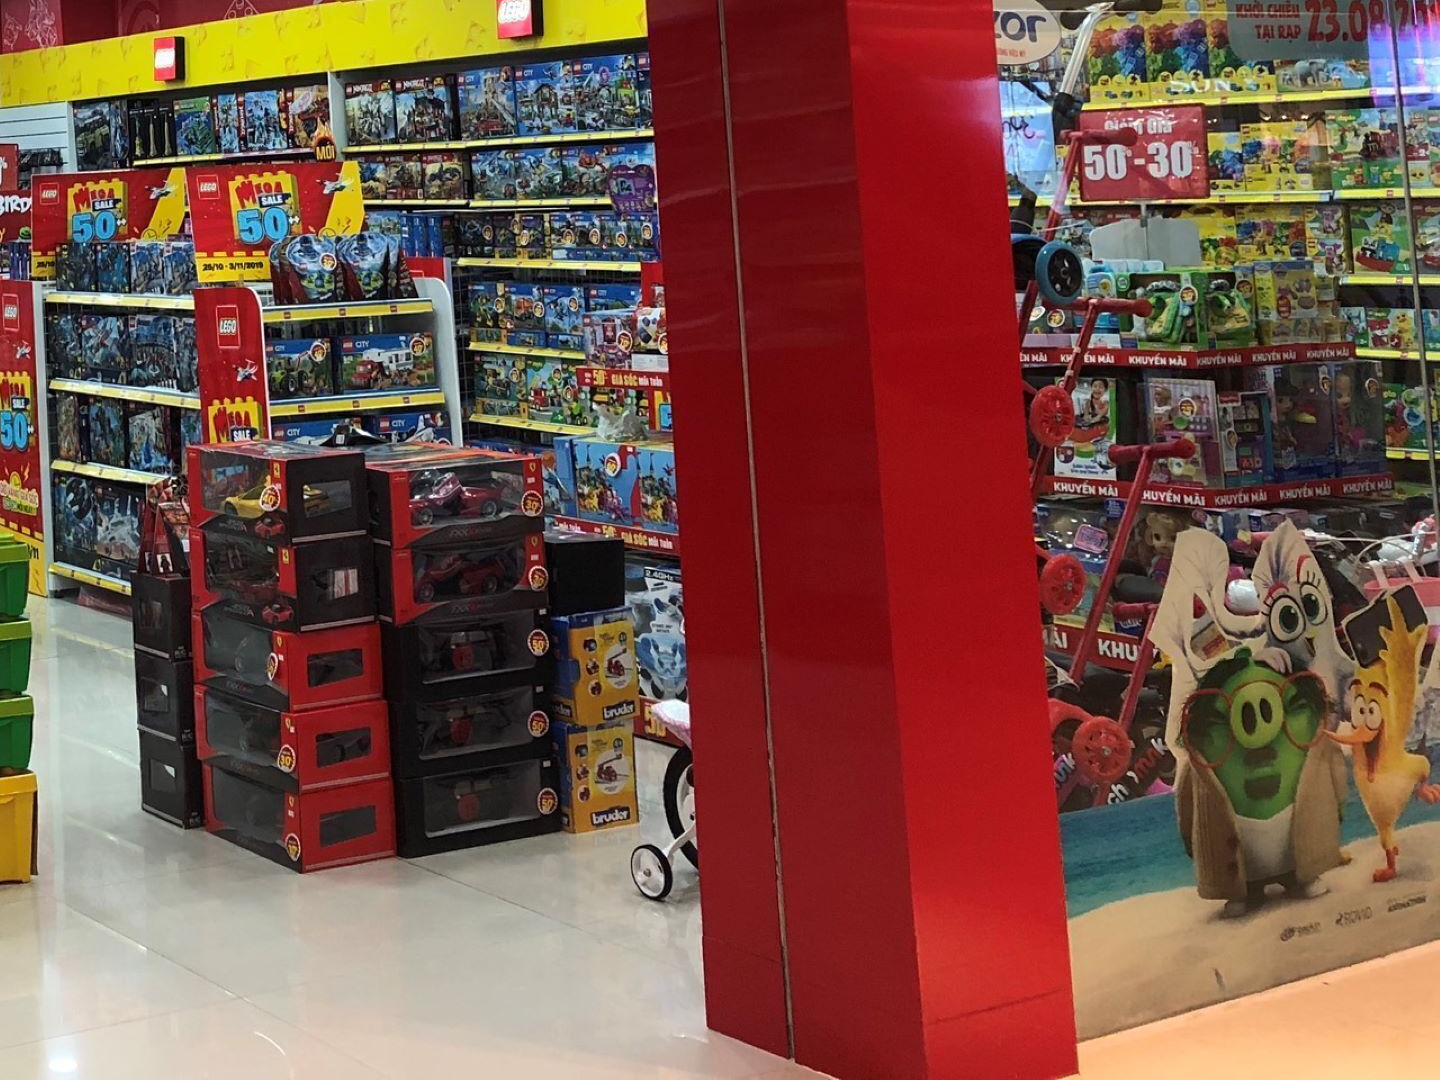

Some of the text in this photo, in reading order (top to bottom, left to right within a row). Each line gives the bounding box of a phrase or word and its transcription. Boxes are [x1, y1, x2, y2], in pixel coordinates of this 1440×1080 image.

[199, 182, 217, 192] LEGO
[94, 200, 114, 211] SALE
[261, 194, 283, 207] SALE
[219, 318, 237, 335] LEGO
[355, 340, 370, 349] CITY
[1060, 350, 1099, 364] KHẾN
[1128, 351, 1167, 366] KHUYẾN
[391, 419, 406, 428] CITY
[232, 428, 252, 442] SALE
[286, 427, 301, 437] CITY
[1054, 480, 1097, 497] KHUYẾN
[1143, 487, 1182, 504] HUYẾN
[602, 700, 635, 721] bruder
[591, 807, 630, 826] bruder
